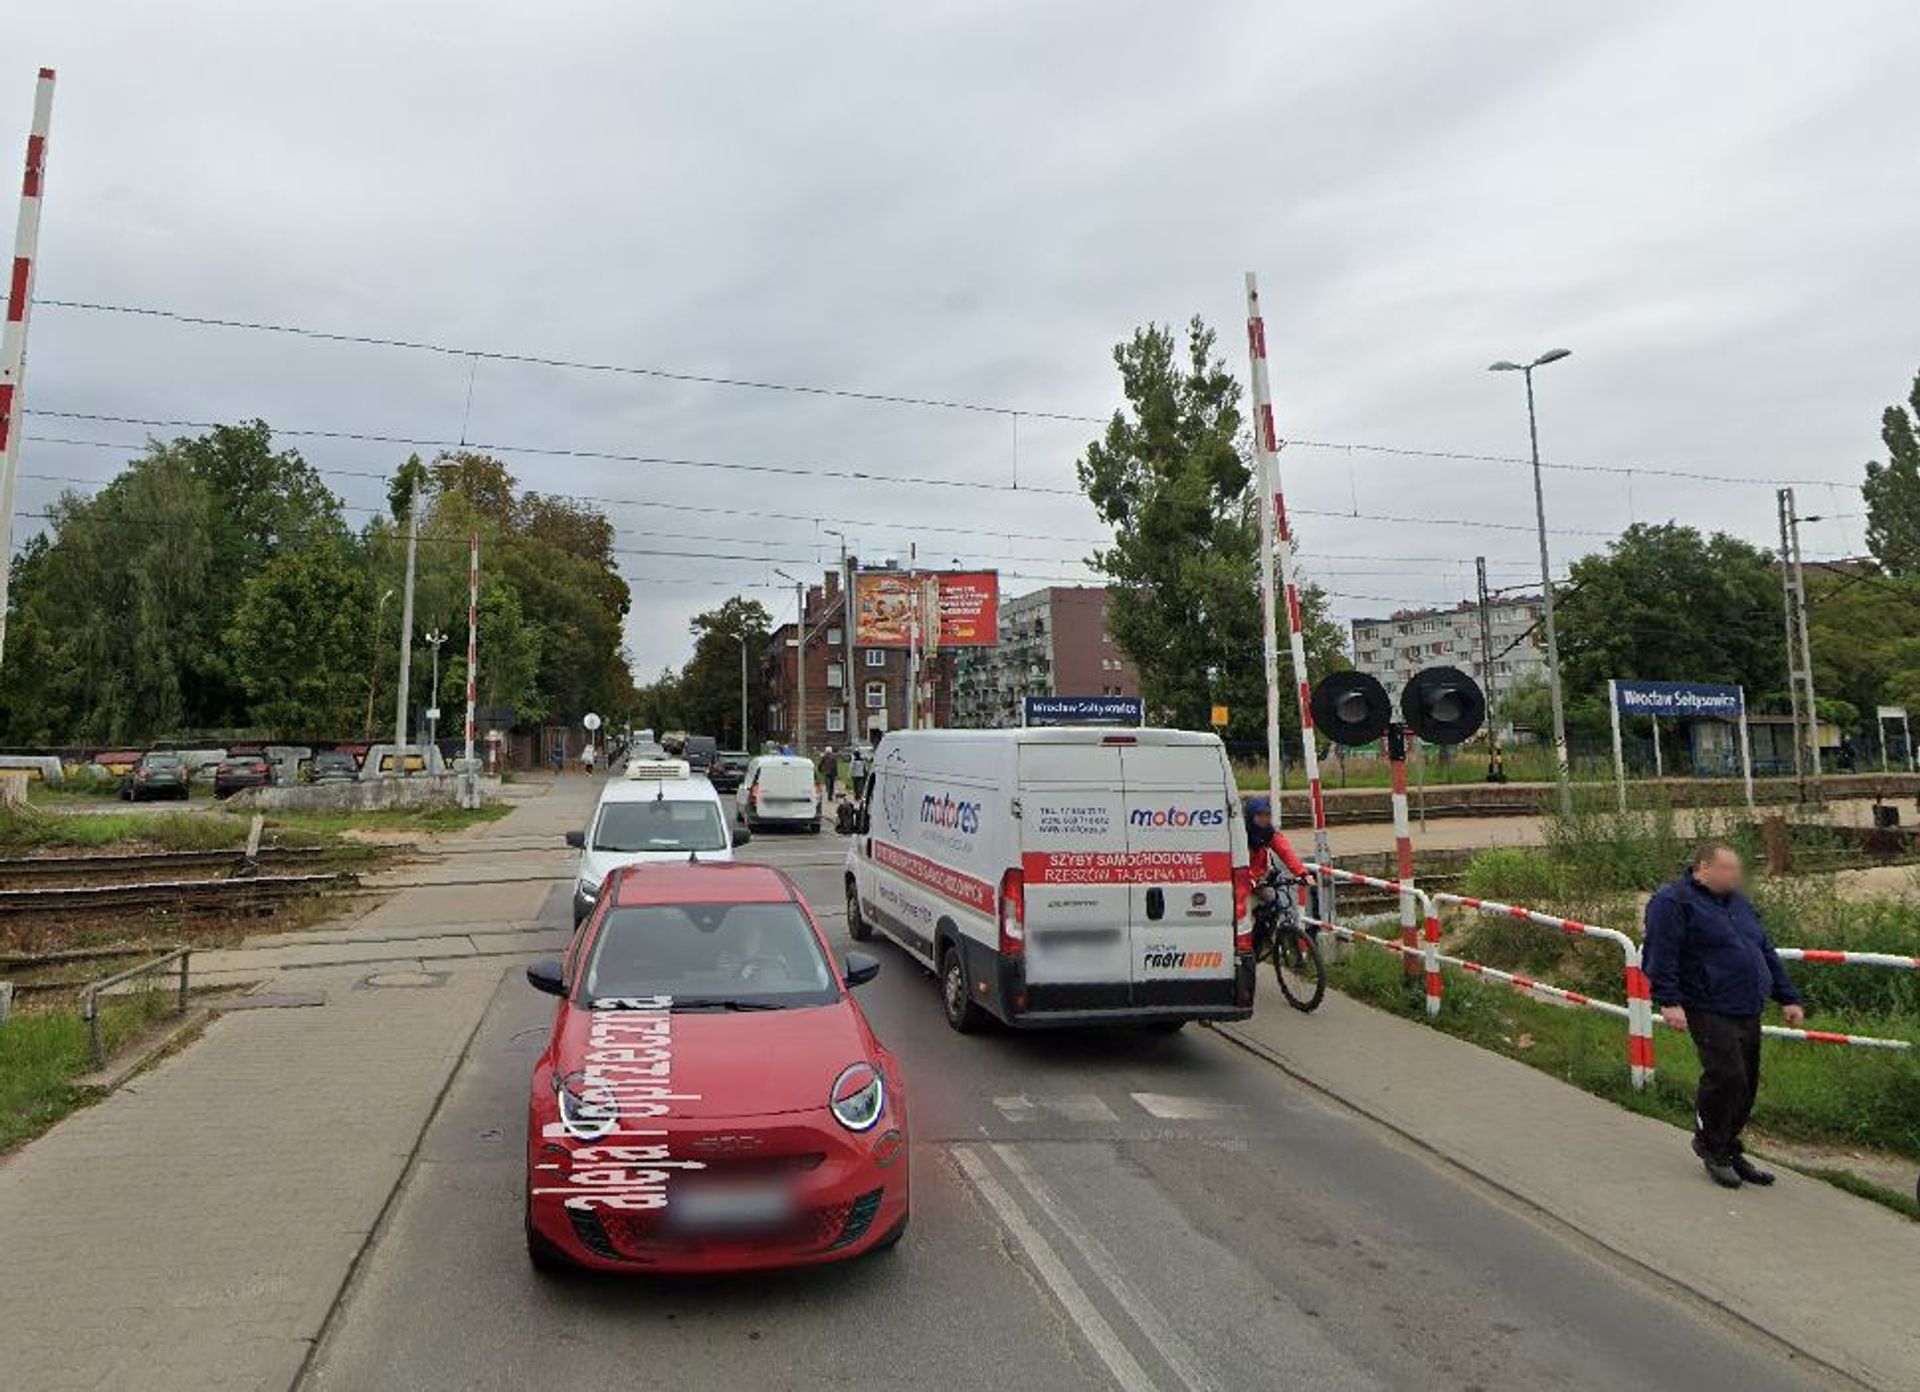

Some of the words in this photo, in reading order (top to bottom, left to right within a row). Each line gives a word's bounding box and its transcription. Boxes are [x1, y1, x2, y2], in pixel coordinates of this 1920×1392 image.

[920, 792, 981, 834] motores
[1129, 805, 1223, 827] motores
[1050, 854, 1095, 867] SZYBY
